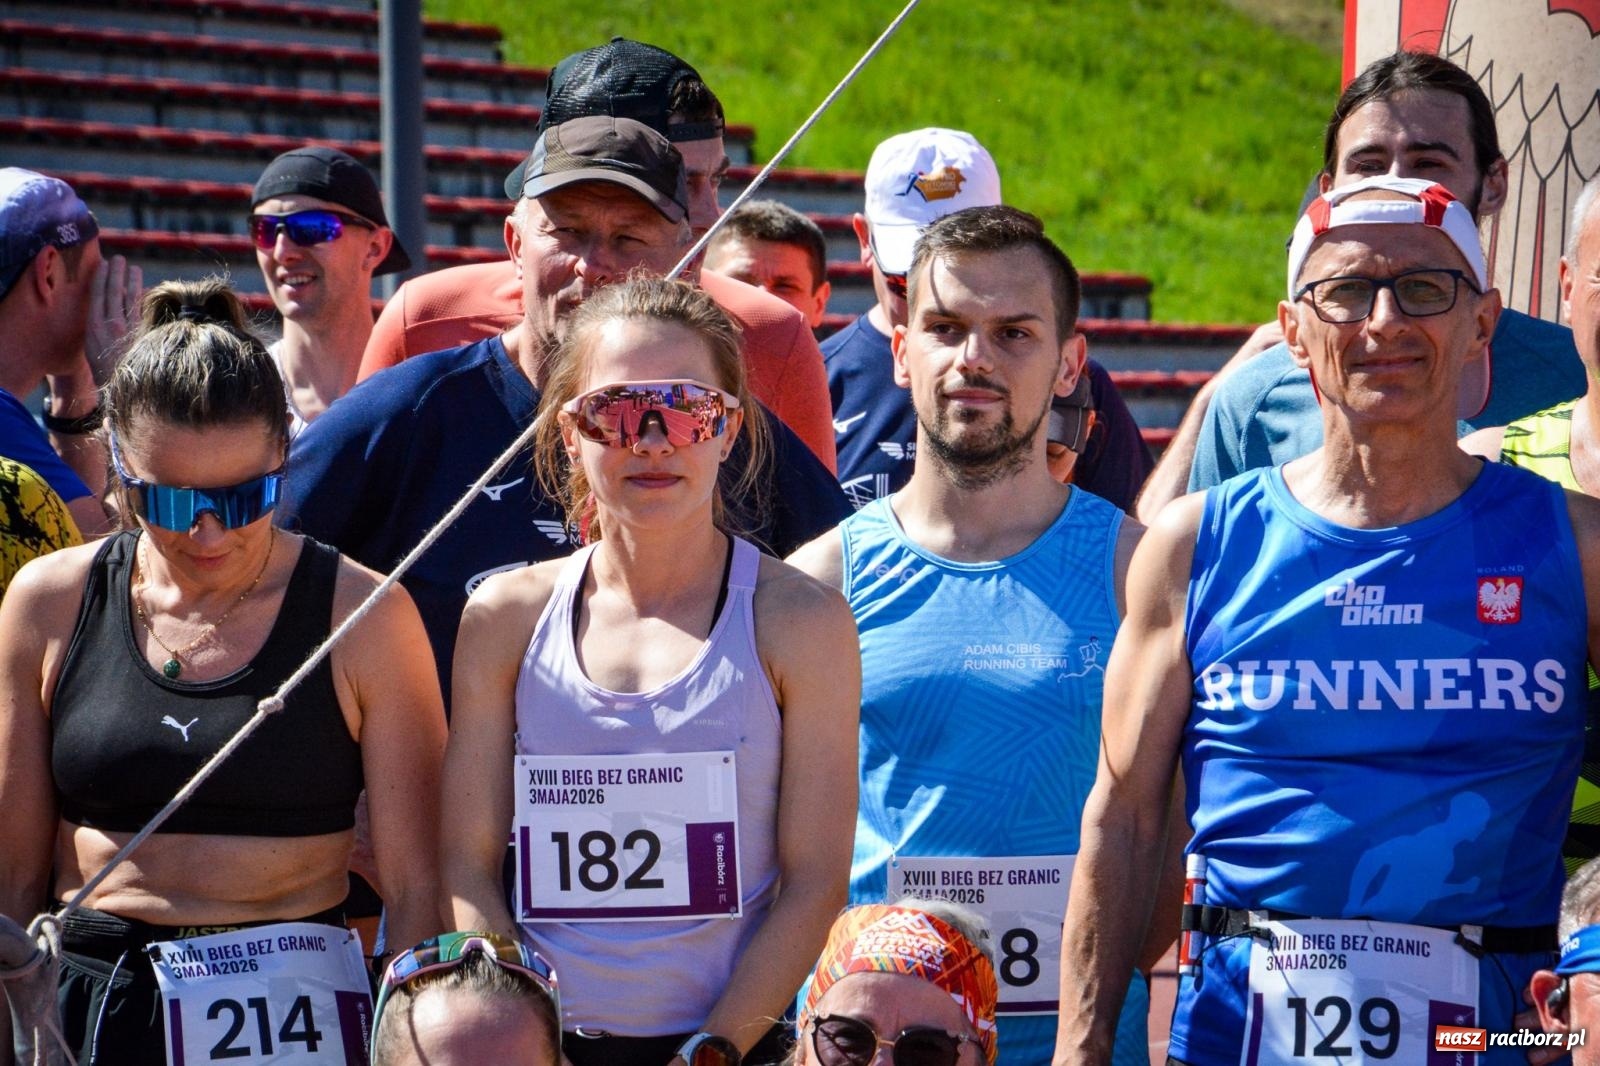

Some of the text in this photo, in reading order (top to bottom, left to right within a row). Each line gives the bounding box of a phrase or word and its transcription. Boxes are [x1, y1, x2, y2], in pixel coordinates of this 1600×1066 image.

[1325, 578, 1386, 606] eko
[1341, 603, 1424, 626] okna
[964, 643, 1041, 655] ADAM CIBIS
[964, 659, 1067, 670] RUNNING TEAM
[1195, 658, 1566, 714] RUNNERS
[529, 766, 684, 786] XVIII BIEG BEZ GRANIC
[529, 788, 605, 805] 3MAJA2026
[551, 829, 664, 893] 182
[903, 868, 1060, 886] XVIII BIEG BEZ GRANIC
[168, 935, 327, 965] XVIII BIEG BEZ GRANIC
[1267, 934, 1431, 958] XVIII BIEG BEZ GRANIC
[173, 958, 259, 980] 3MAJA2026
[1266, 954, 1347, 971] 3MAJA2026
[206, 995, 323, 1060] 214
[1287, 996, 1400, 1060] 129
